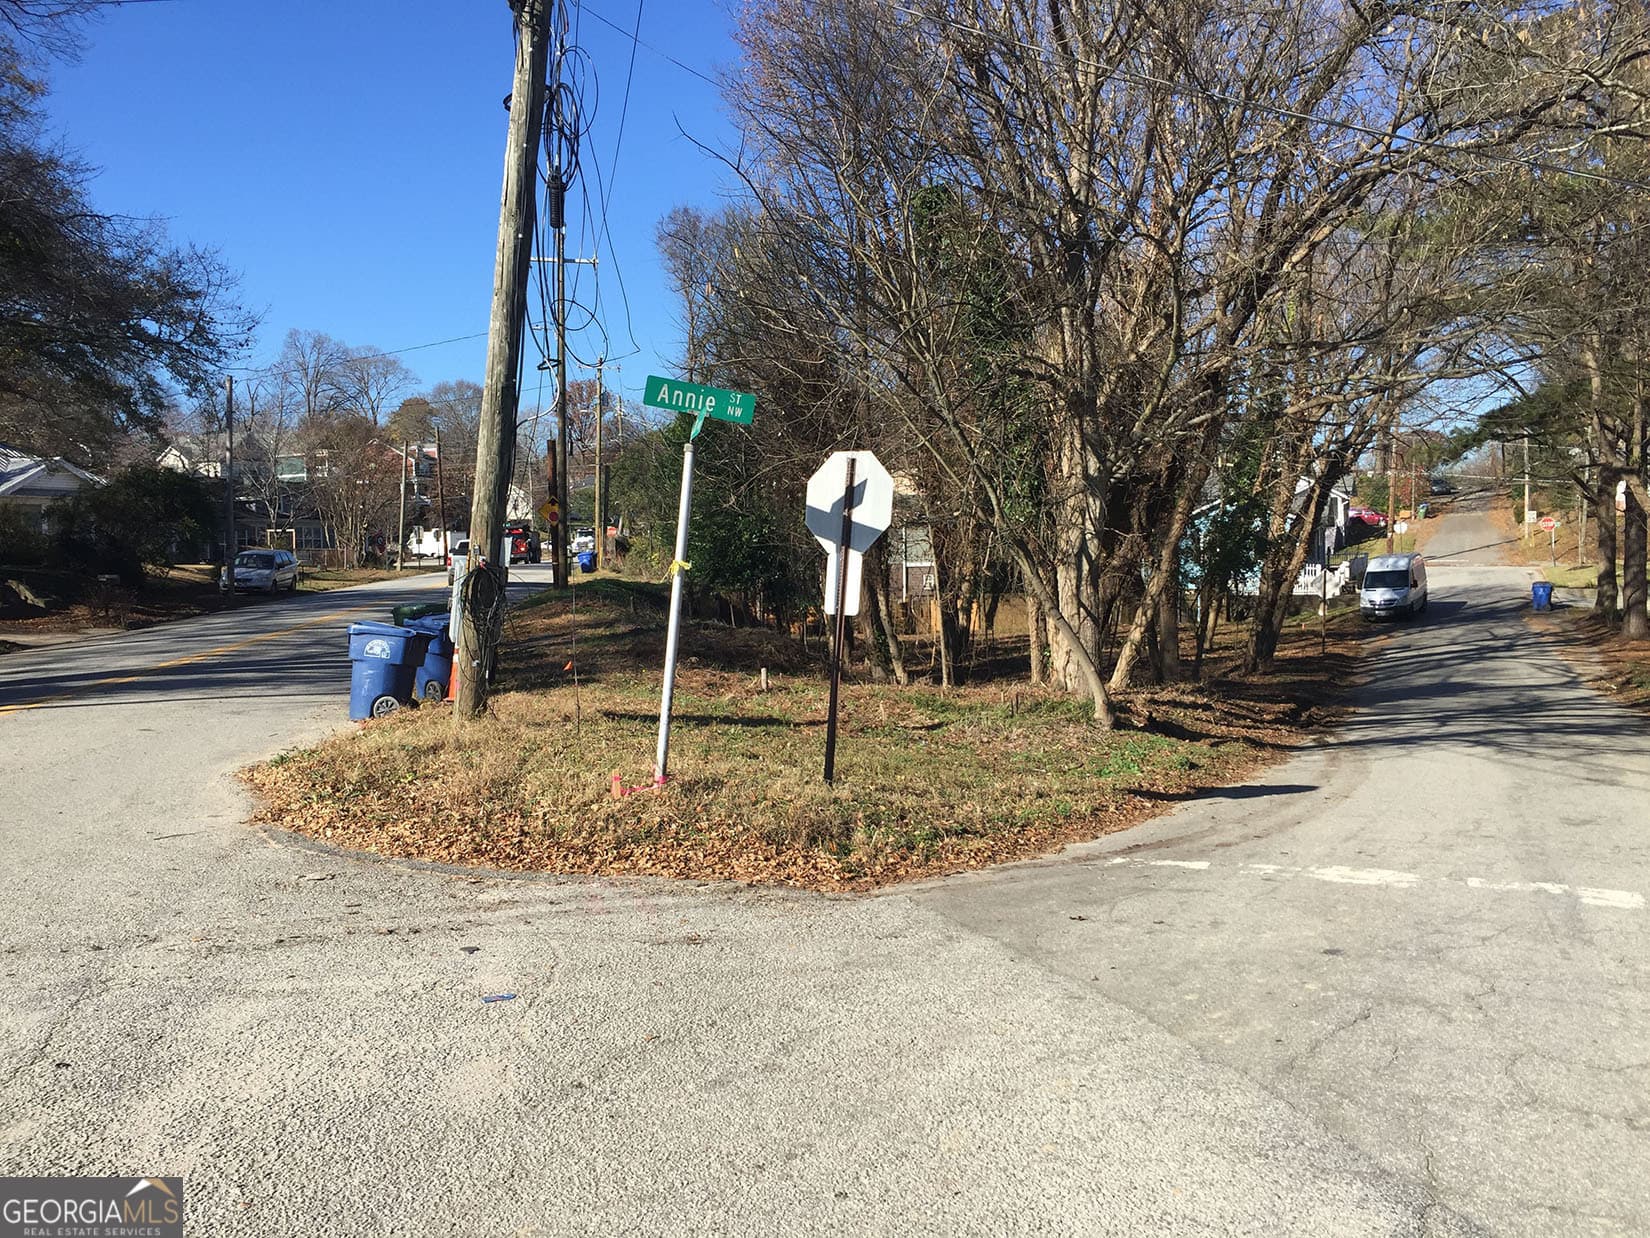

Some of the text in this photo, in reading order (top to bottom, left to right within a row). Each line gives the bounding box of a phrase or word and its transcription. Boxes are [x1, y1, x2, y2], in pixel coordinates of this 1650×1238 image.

[656, 383, 742, 412] Annie ST
[727, 406, 743, 417] NW
